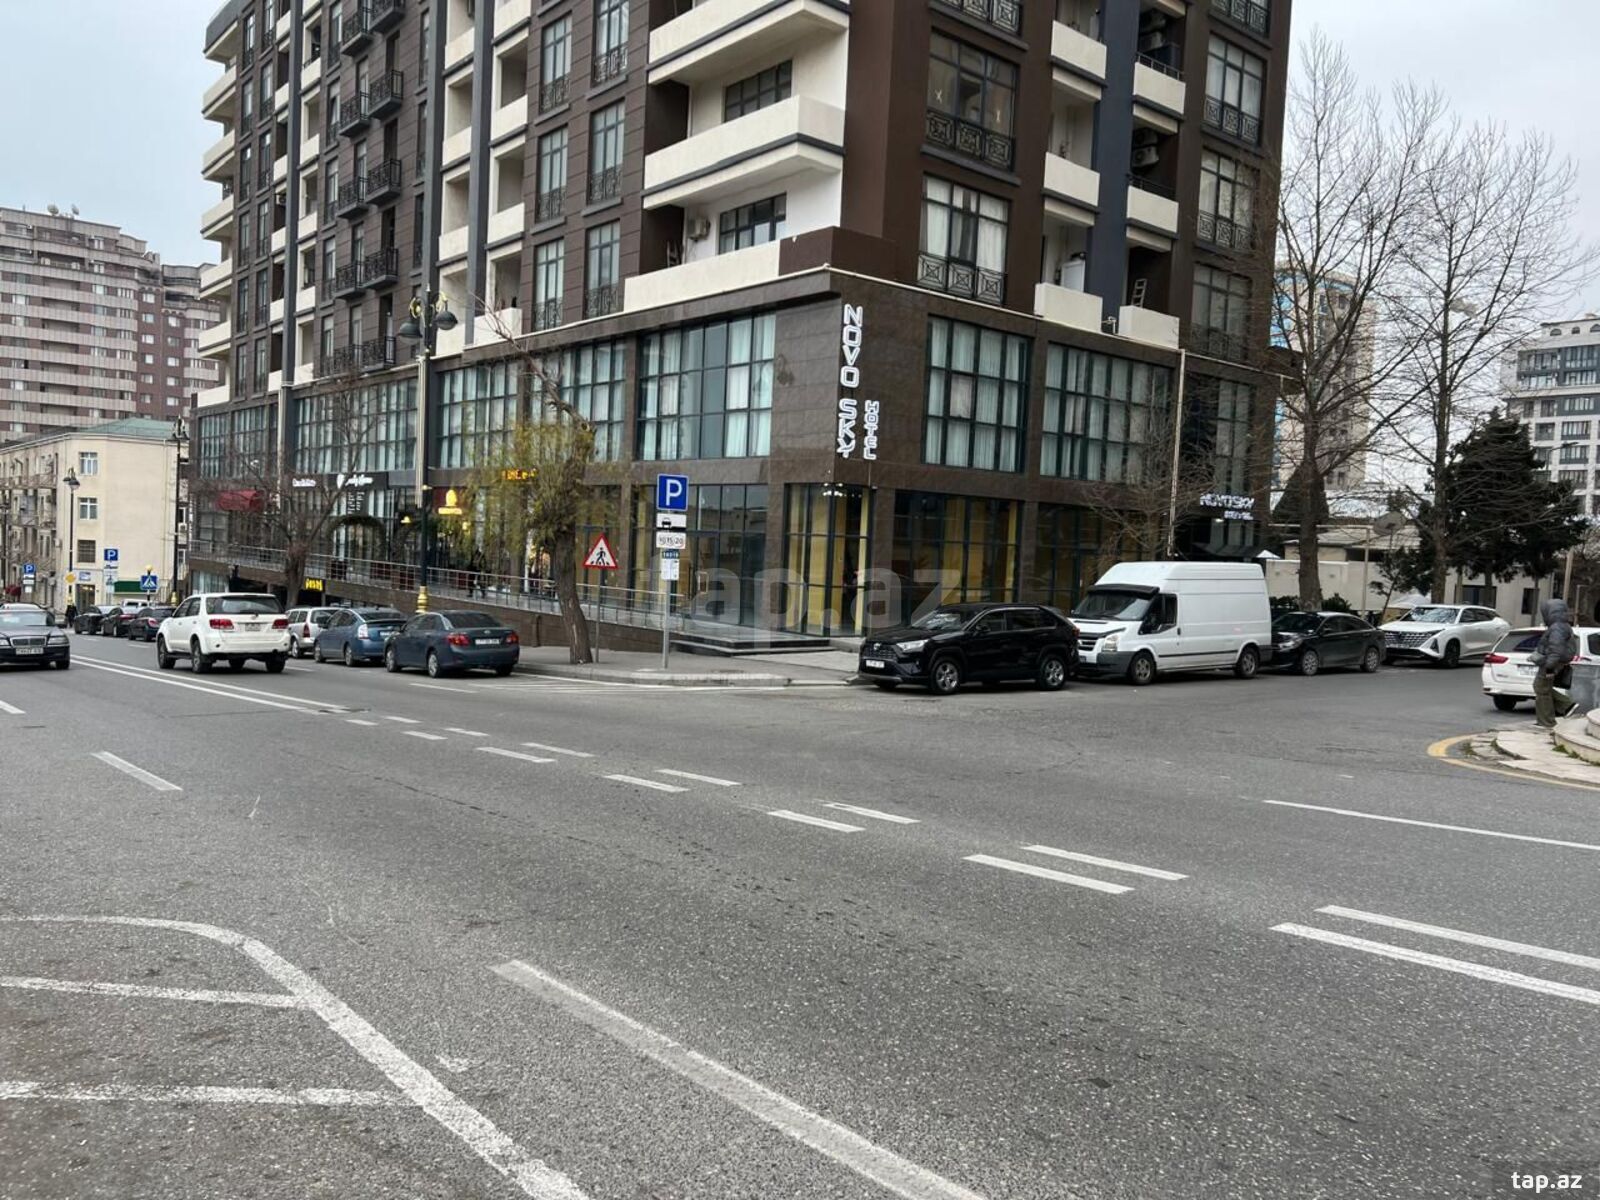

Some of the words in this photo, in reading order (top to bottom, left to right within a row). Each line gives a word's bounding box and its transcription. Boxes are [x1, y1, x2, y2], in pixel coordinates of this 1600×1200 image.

[839, 303, 864, 388] NOVO
[836, 398, 858, 459] SKY
[863, 399, 880, 460] HOTEL
[665, 479, 683, 506] P
[108, 551, 116, 559] P
